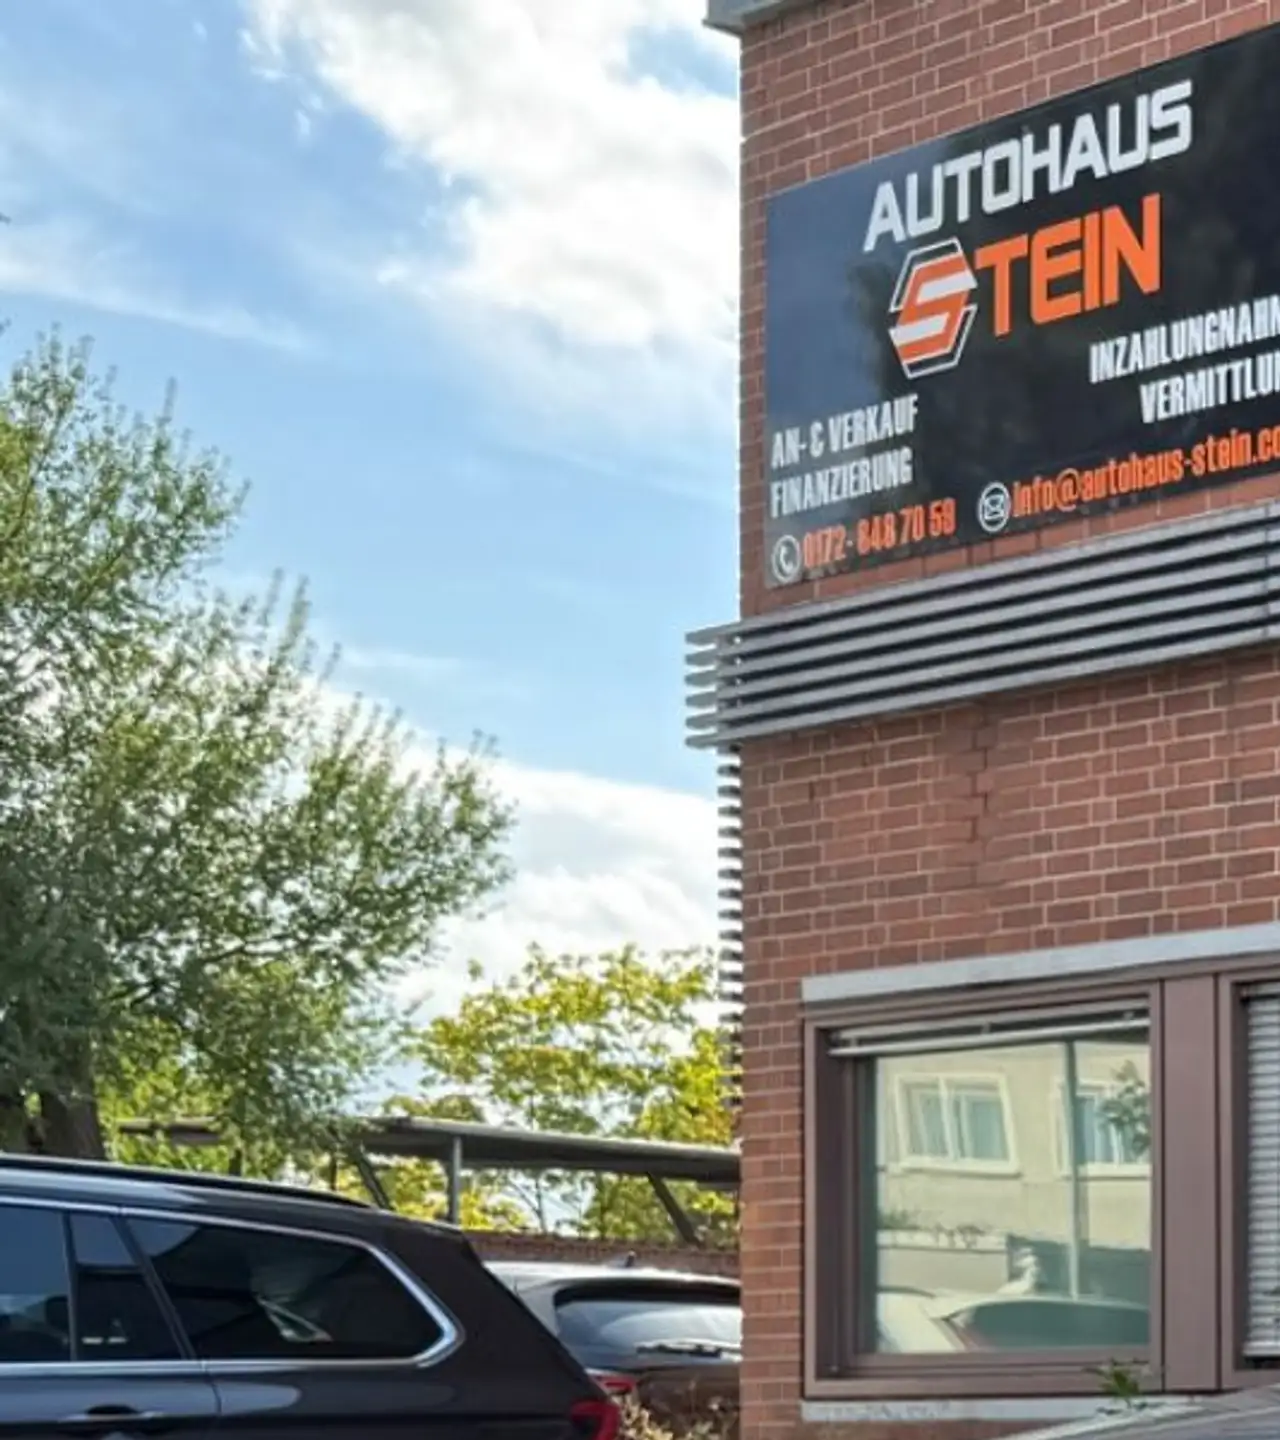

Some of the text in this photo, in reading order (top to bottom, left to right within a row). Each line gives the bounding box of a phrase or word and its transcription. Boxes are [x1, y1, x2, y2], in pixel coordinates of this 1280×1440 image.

[864, 80, 1192, 252] AUTOHAUS
[889, 193, 1160, 367] STEIN
[771, 427, 807, 469] AN-
[828, 393, 918, 453] VERKAUF
[771, 446, 913, 518] FINANZIERUNG
[900, 505, 925, 545] 70
